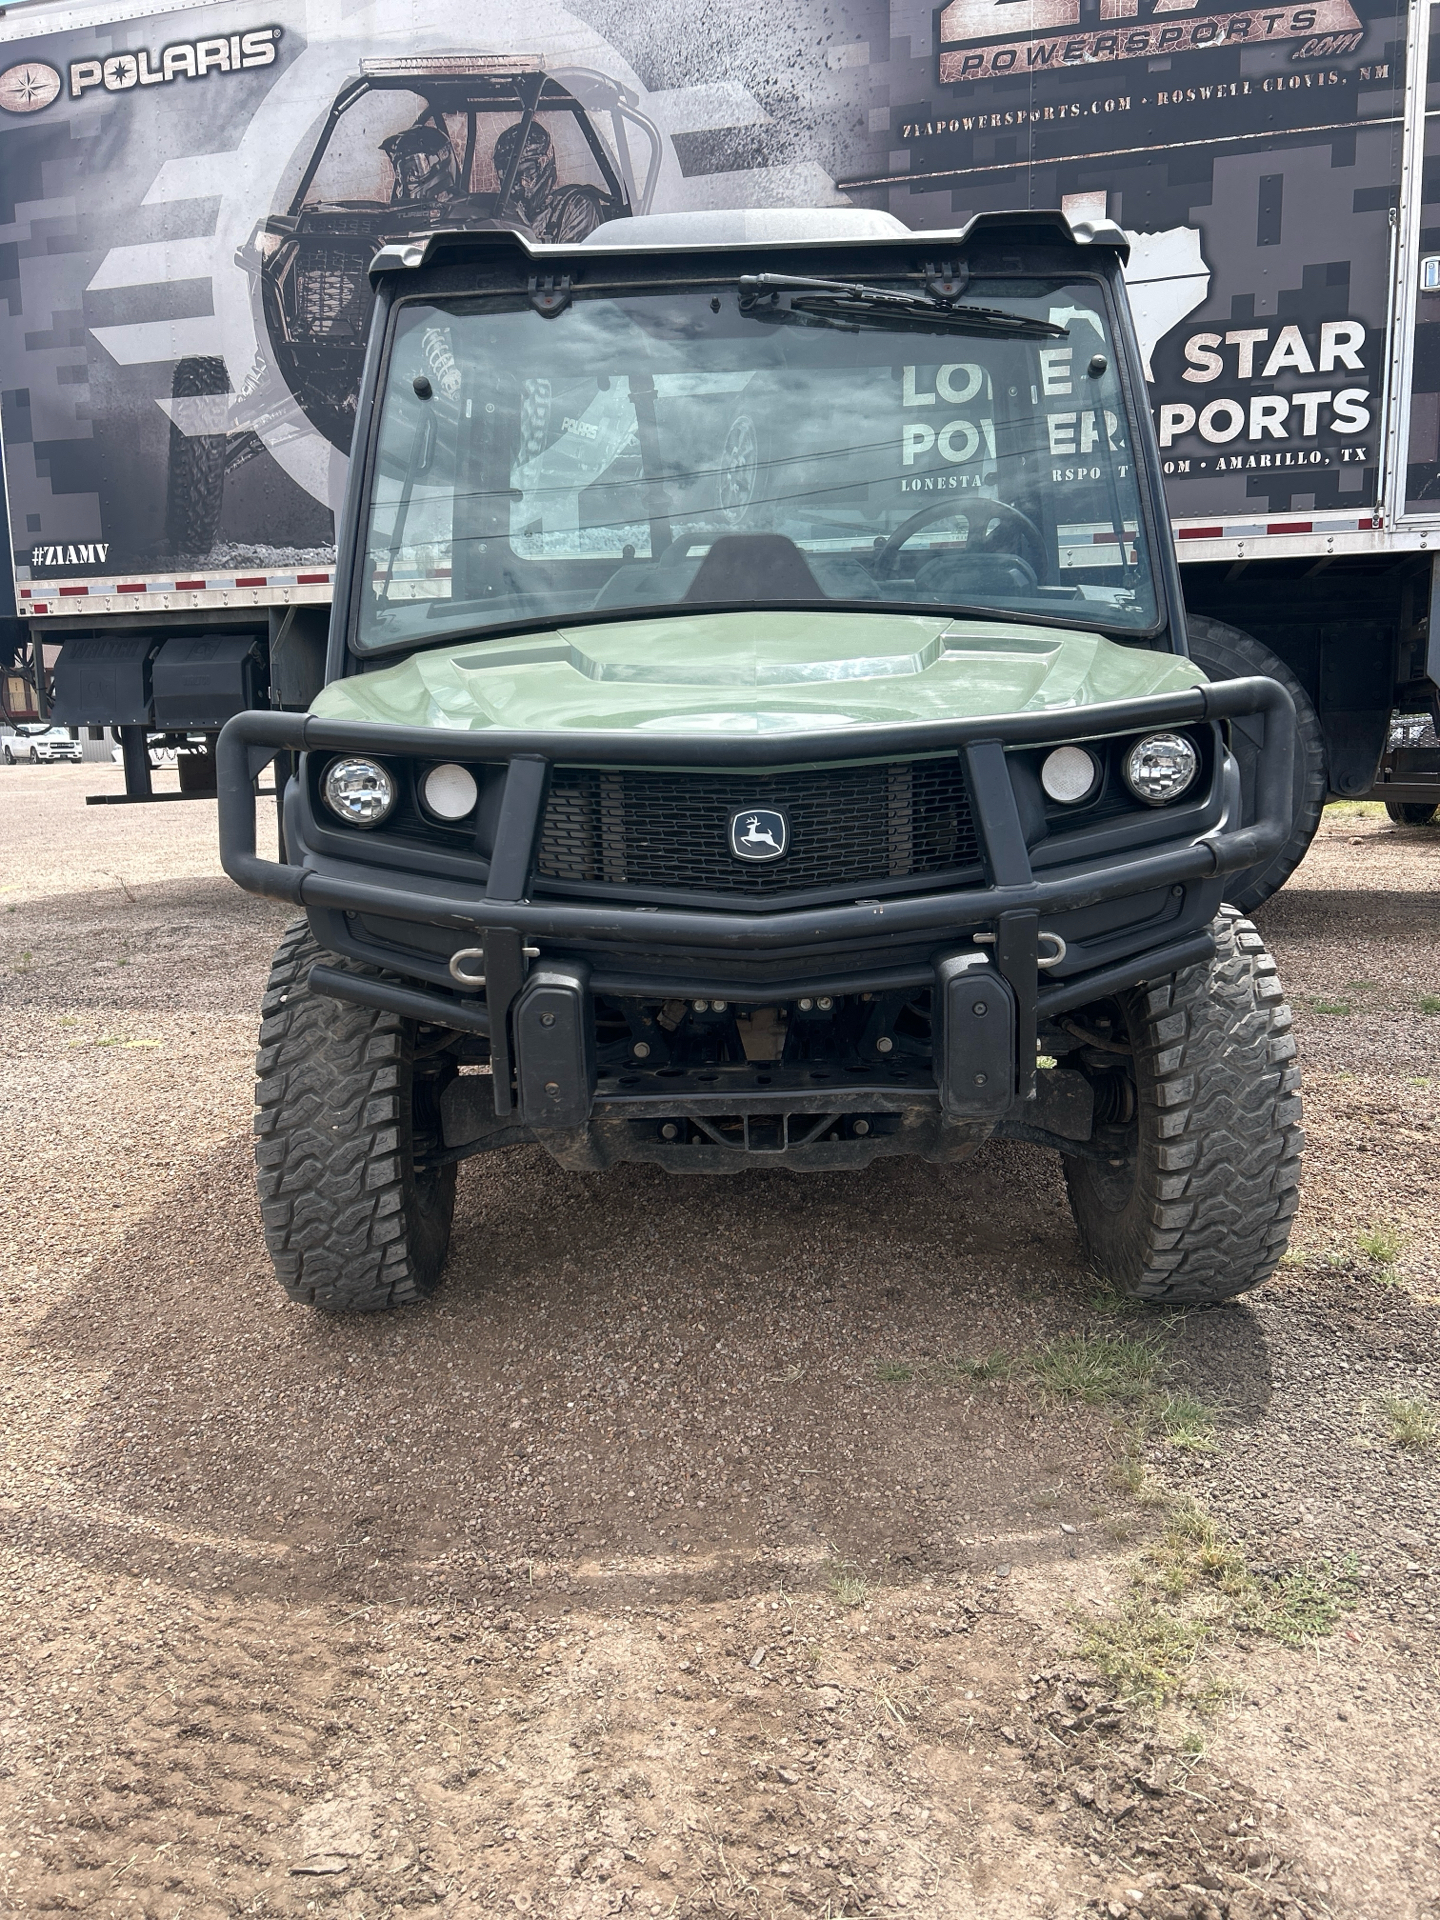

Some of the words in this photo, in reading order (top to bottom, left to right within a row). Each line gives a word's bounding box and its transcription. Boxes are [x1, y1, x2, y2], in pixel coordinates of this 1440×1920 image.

[961, 9, 1317, 75] POWERSPORTS
[1157, 81, 1253, 106] ROSWELL
[1359, 64, 1390, 81] NM
[903, 96, 1132, 138] ZIAPOWERSPORTS.COM
[903, 347, 1073, 407] LOE
[1181, 320, 1366, 383] STAR
[561, 416, 599, 440] POLARIS
[902, 388, 1371, 466] POERPORTS
[1216, 450, 1330, 471] AMARILLO,
[1341, 447, 1367, 462] TX
[32, 543, 109, 566] #ZIAMV
